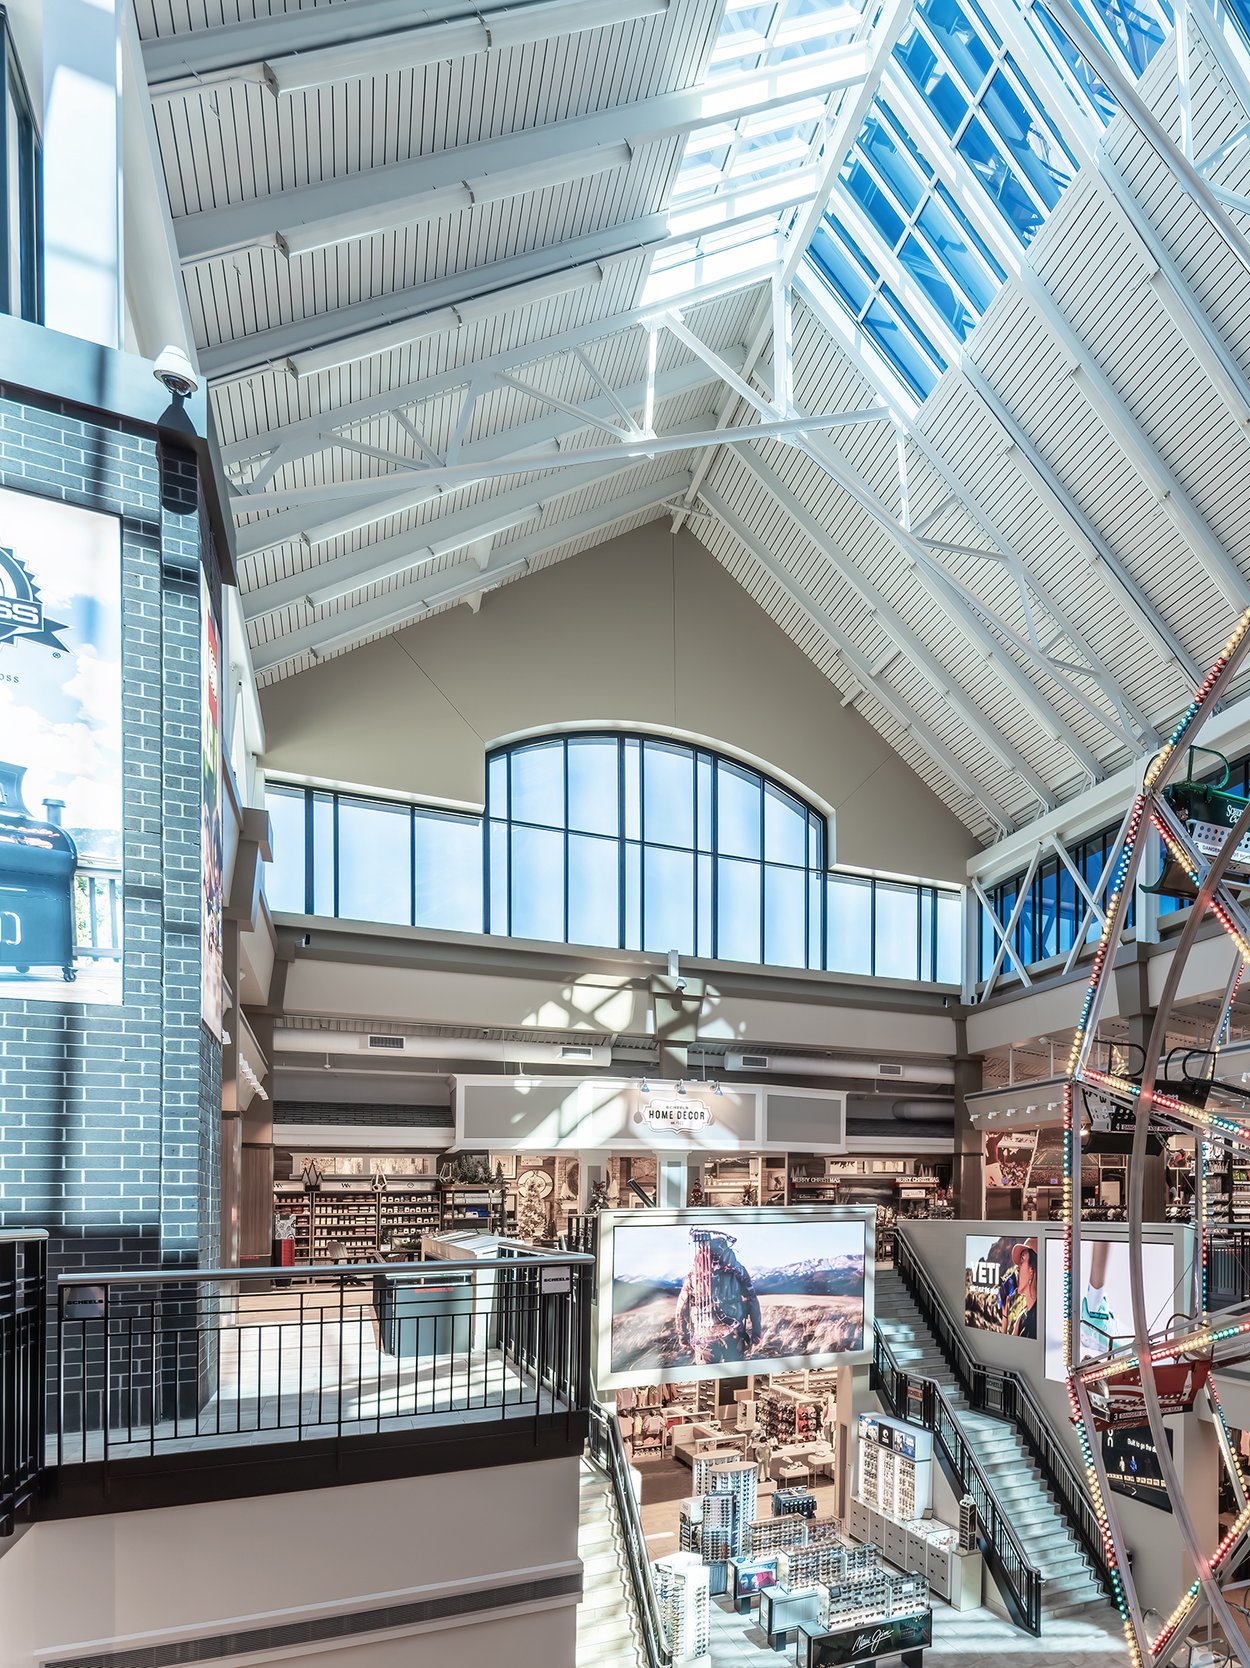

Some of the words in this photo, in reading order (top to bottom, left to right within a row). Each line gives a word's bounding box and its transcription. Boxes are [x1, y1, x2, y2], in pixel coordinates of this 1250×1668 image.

[648, 1110, 673, 1120] HOME
[677, 1111, 705, 1121] DECOR
[971, 1261, 1001, 1285] YETI
[1113, 1413, 1118, 1421] 3
[851, 1634, 872, 1652] Maui
[872, 1628, 894, 1653] Jim
